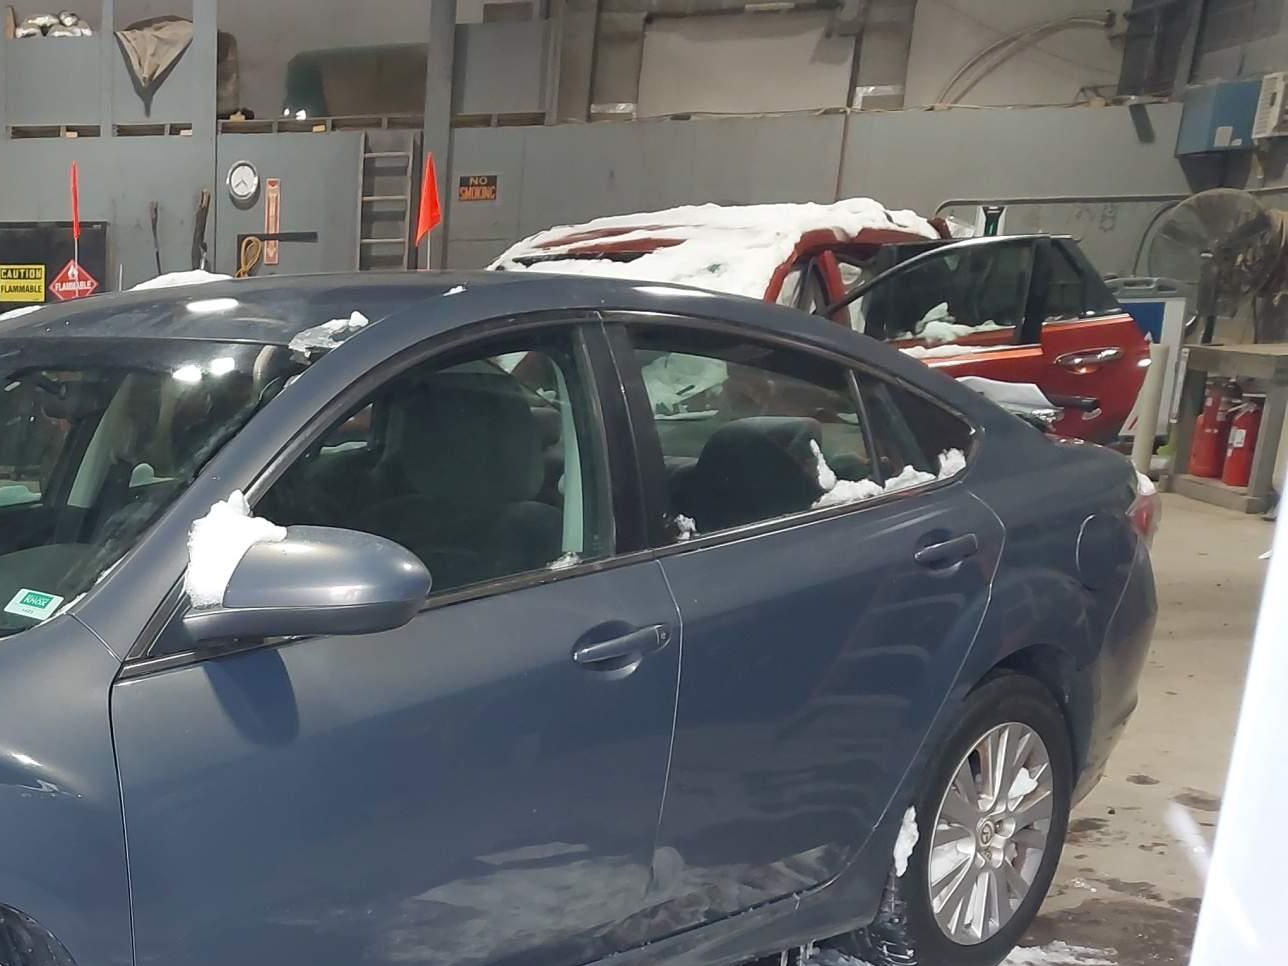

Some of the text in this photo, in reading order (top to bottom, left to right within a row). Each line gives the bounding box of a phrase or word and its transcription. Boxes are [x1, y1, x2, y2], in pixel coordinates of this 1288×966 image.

[470, 176, 488, 185] NO
[459, 186, 496, 200] SMOKING
[0, 269, 42, 279] CAUTION
[0, 284, 42, 294] FLAMMABLE
